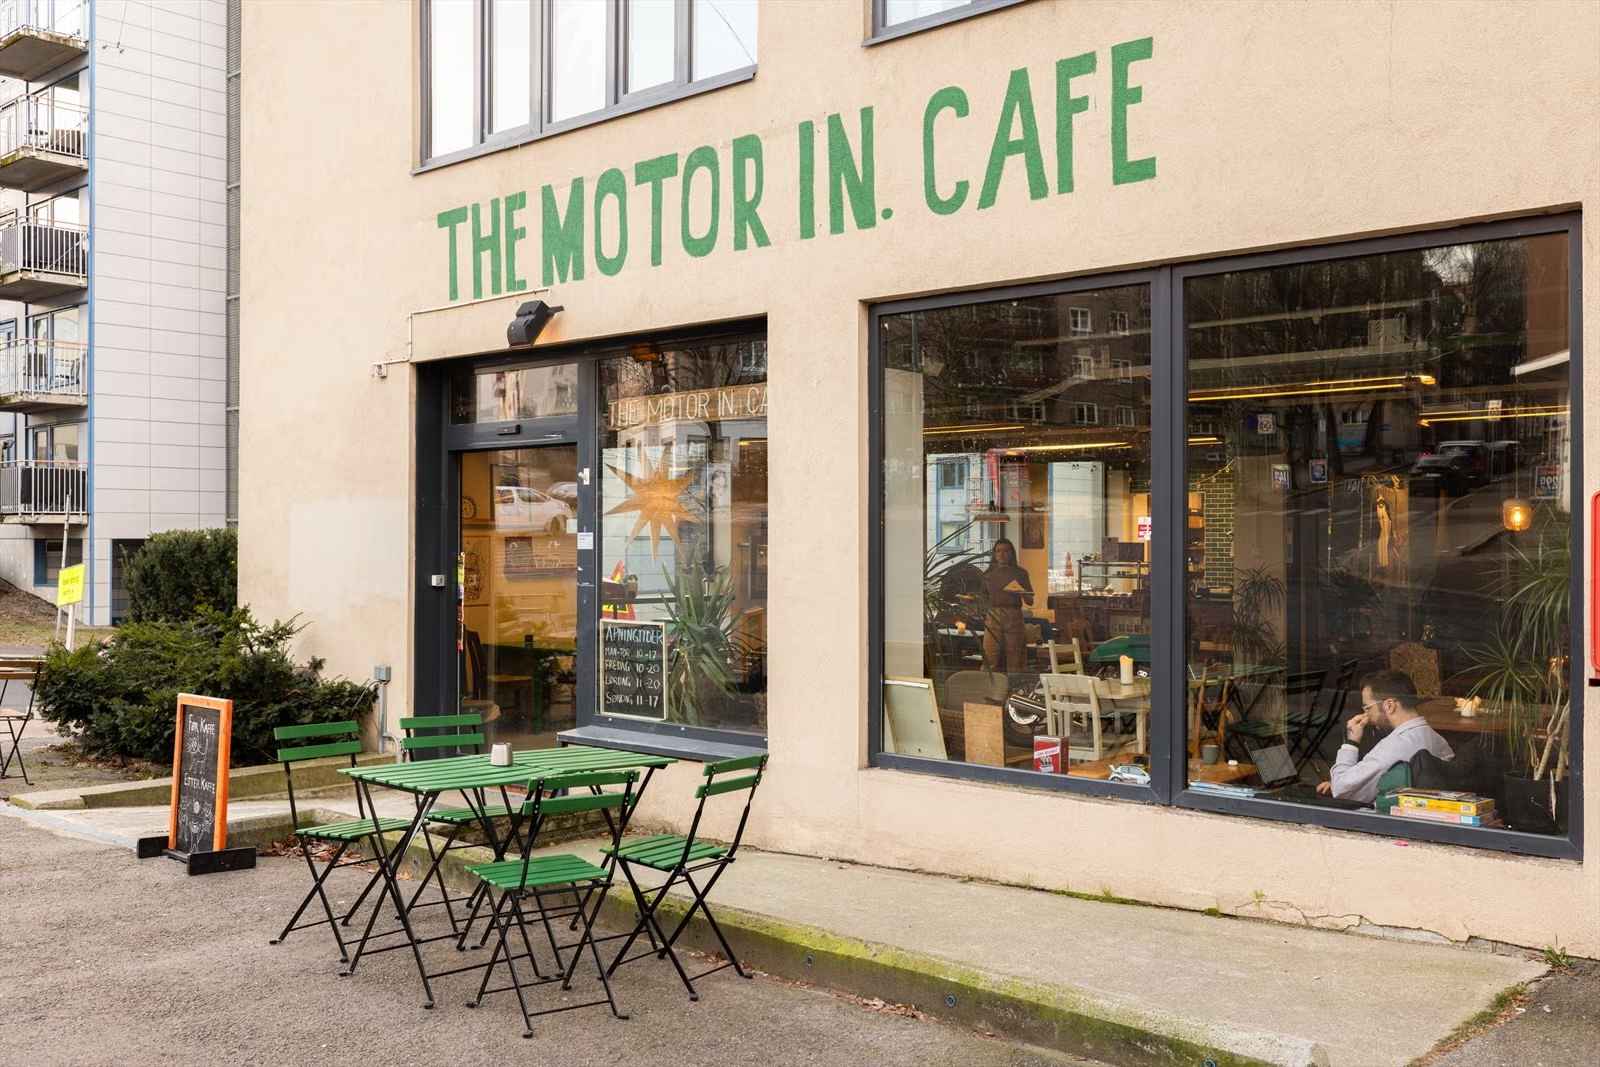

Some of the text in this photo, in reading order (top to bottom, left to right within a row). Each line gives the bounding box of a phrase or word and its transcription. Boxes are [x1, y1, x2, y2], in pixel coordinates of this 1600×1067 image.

[437, 37, 1157, 301] THE MOTOR IN. CAFE
[607, 399, 640, 426] THE
[647, 393, 709, 423] MOTOR
[605, 660, 630, 672] FREDAG
